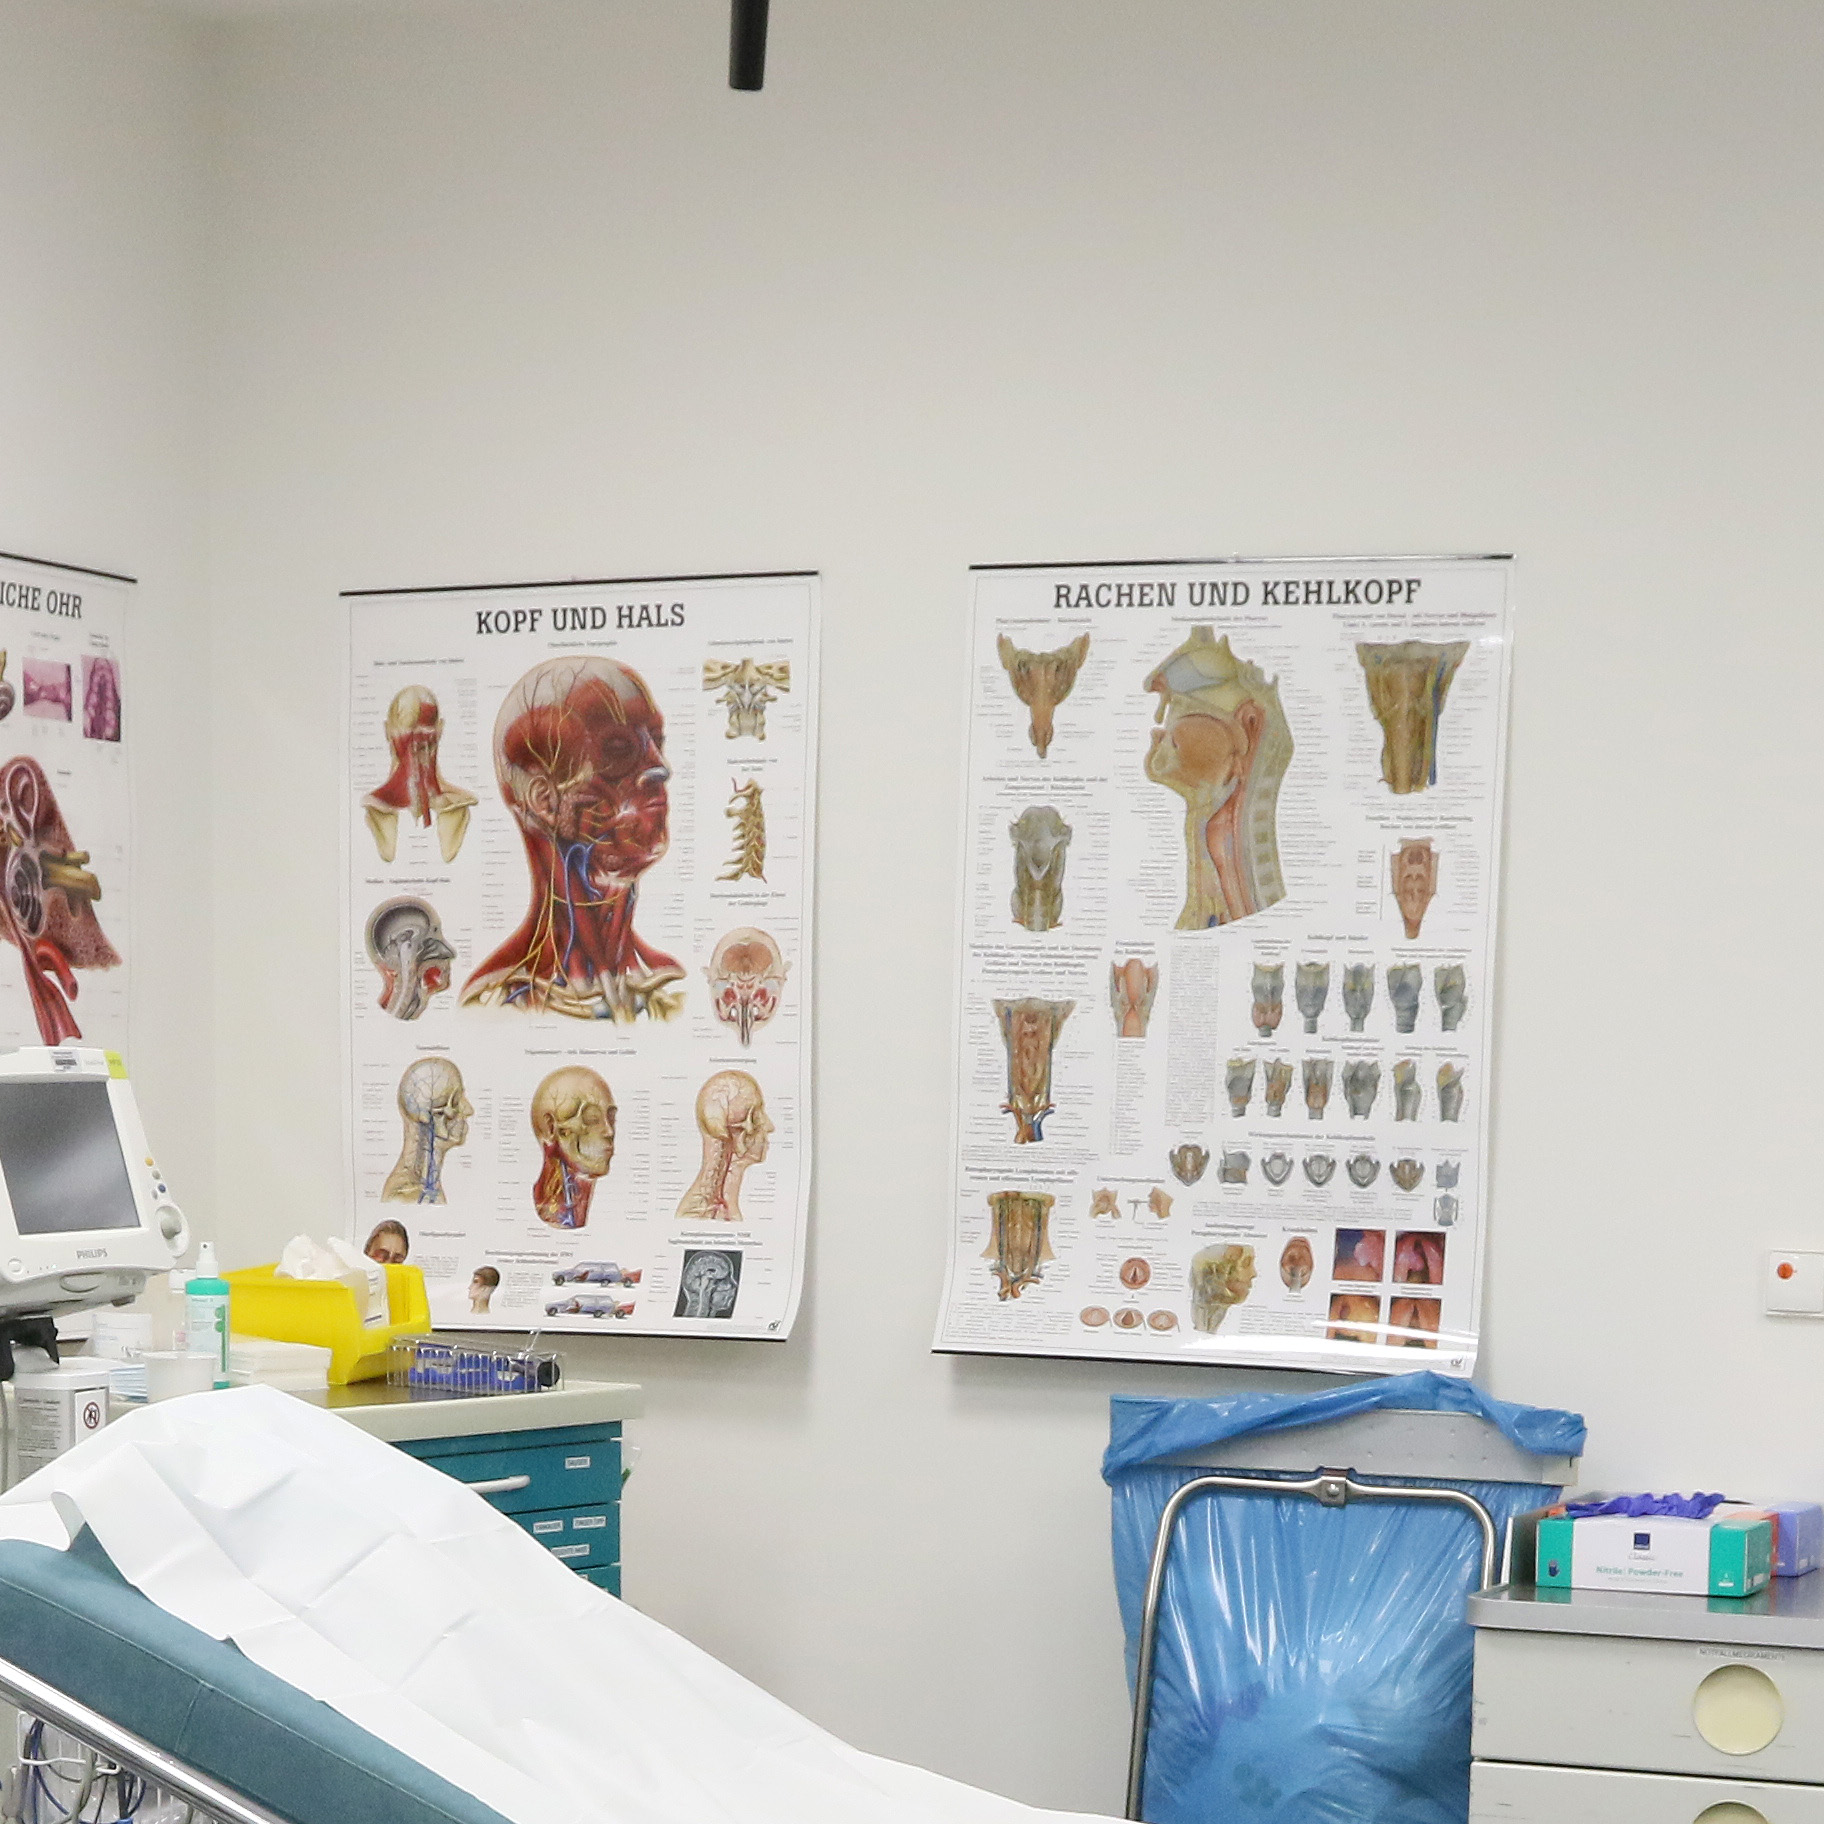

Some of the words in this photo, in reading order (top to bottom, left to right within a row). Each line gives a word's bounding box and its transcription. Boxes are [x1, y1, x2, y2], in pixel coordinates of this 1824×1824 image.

[46, 590, 83, 619] OHR
[1053, 581, 1178, 609] RACHEN
[1188, 581, 1251, 607] UND
[1261, 578, 1423, 606] KEHLKOPF
[475, 609, 543, 635] KOPF
[551, 607, 607, 631] UND
[616, 603, 686, 629] HALS
[76, 1247, 108, 1259] PHILIPS
[1596, 1565, 1623, 1576] Nitrile
[1627, 1567, 1684, 1578] Powder-Free
